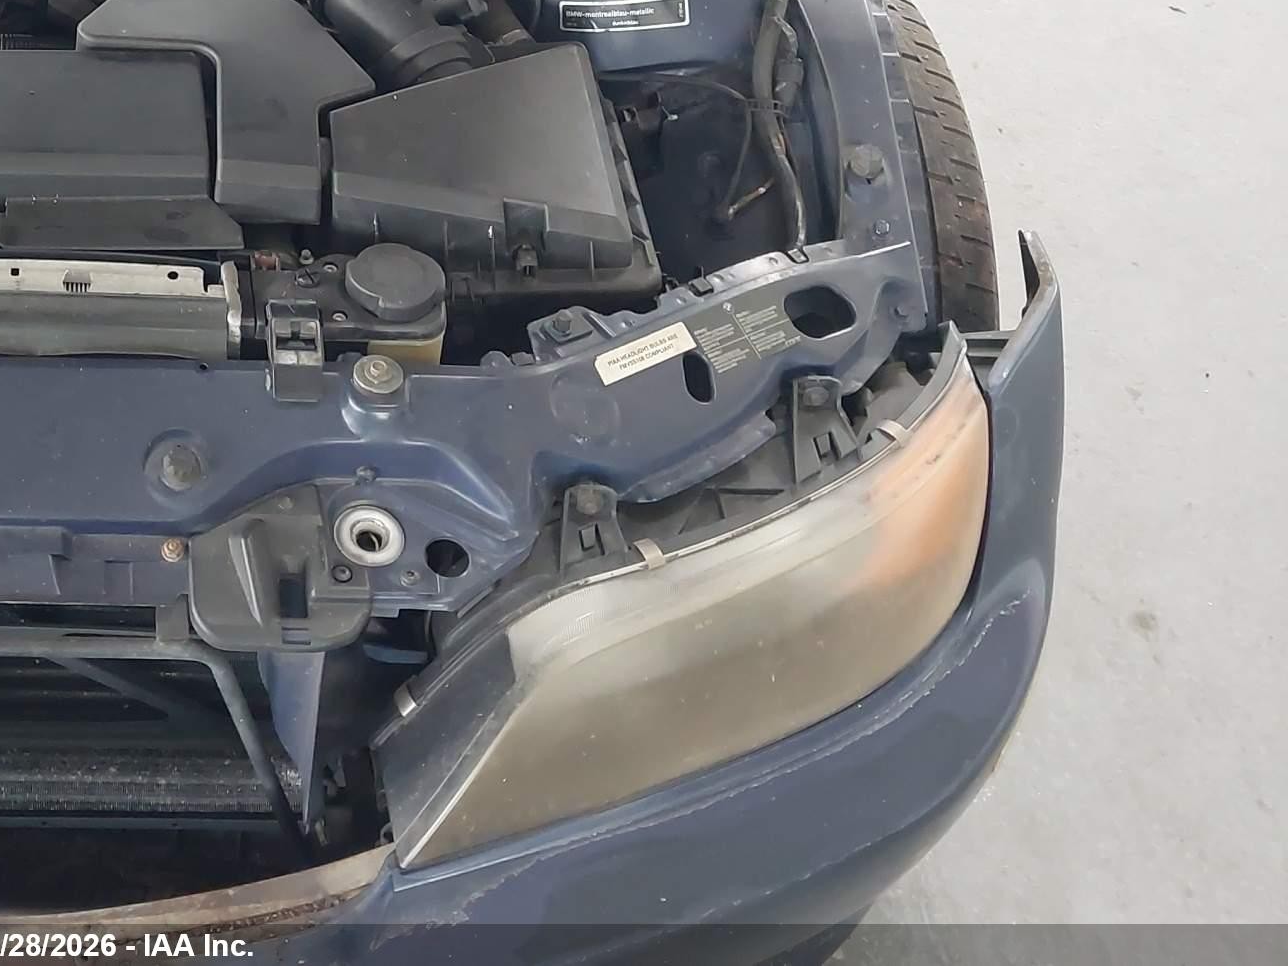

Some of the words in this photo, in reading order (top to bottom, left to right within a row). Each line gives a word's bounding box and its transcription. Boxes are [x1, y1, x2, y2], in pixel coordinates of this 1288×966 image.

[620, 345, 649, 360] HEADLIGHT
[649, 338, 667, 349] BULBS
[667, 333, 678, 341] ARE
[645, 343, 674, 359] COMPLIANT
